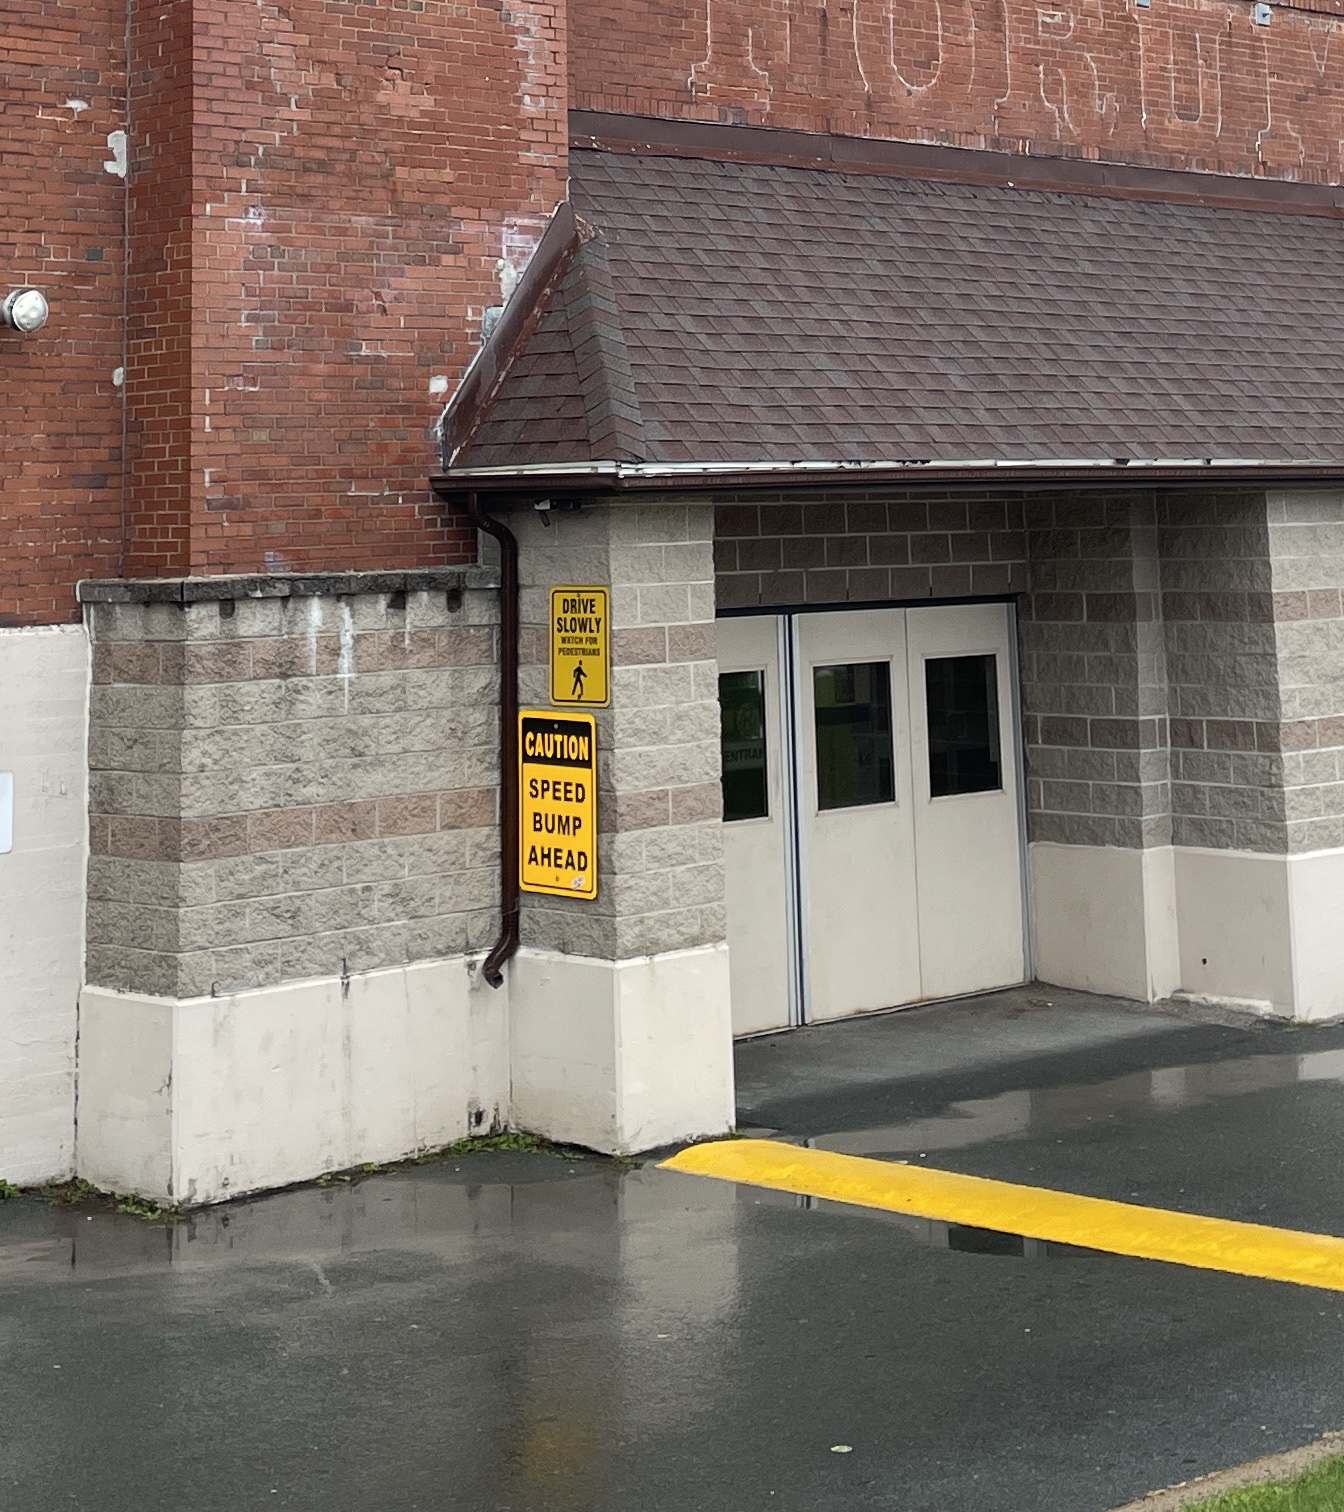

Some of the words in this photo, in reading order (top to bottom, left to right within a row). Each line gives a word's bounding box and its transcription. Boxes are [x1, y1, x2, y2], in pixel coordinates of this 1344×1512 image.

[562, 598, 596, 614] DRIVE
[557, 617, 602, 634] SLOWLY
[525, 731, 589, 761] CAUTION
[529, 778, 586, 803] SPEED
[532, 811, 582, 837] BUMP
[528, 845, 588, 872] AHEAD
